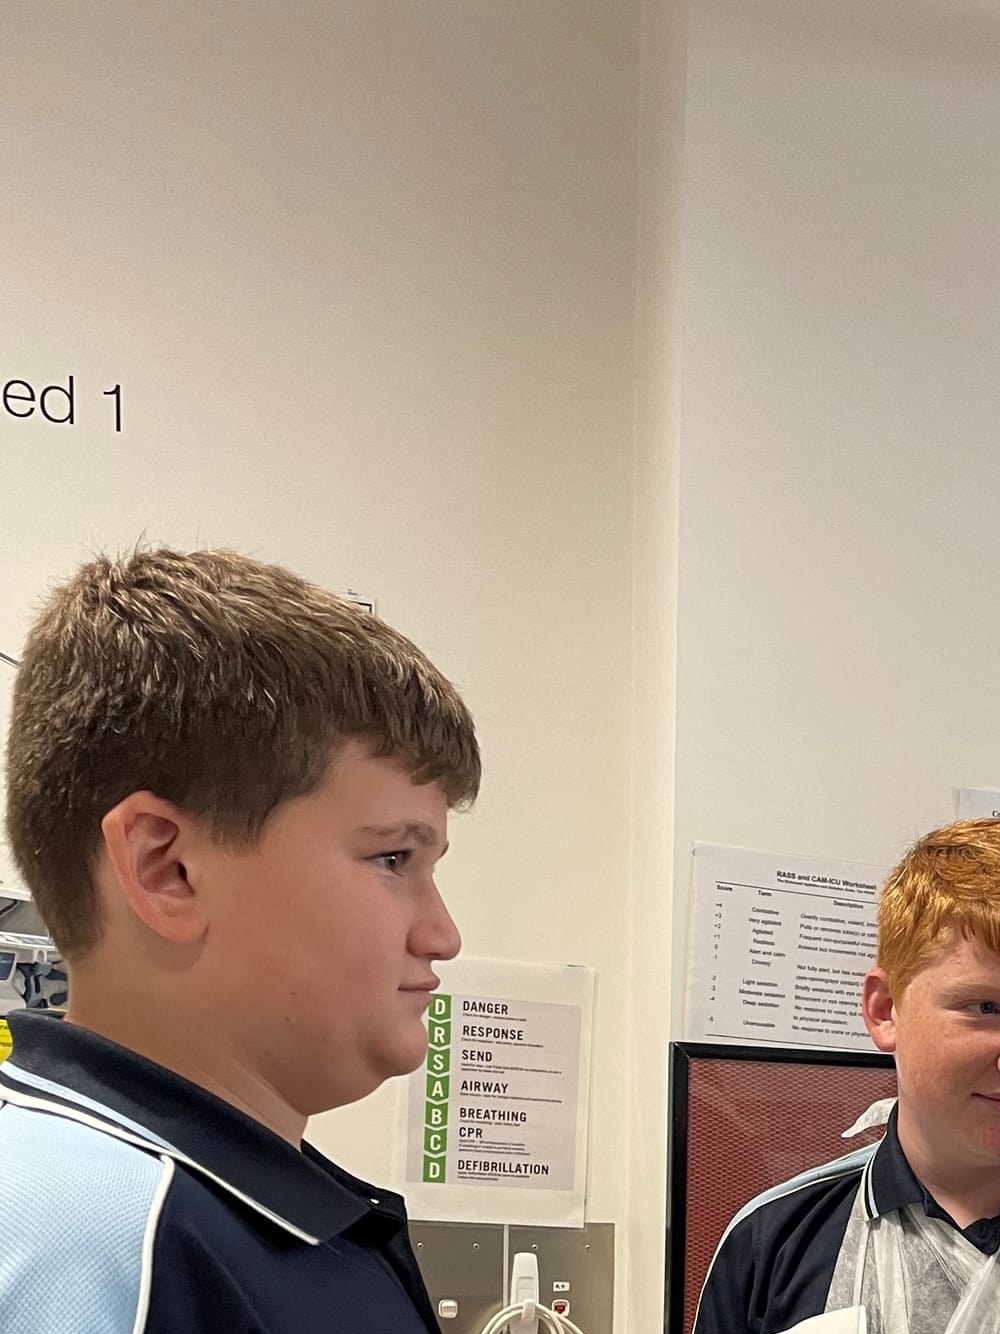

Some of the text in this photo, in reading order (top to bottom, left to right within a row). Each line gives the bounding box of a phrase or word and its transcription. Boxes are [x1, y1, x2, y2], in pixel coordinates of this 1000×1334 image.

[103, 384, 121, 432] 1
[777, 871, 796, 879] RASS
[811, 876, 841, 885] CAM-ICU
[842, 880, 877, 890] Worksheet
[435, 998, 446, 1015] D
[463, 1000, 508, 1015] DANGER
[434, 1026, 445, 1043] R
[463, 1025, 524, 1041] RESPONSE
[433, 1054, 444, 1071] S
[462, 1049, 492, 1062] SEND
[431, 1080, 444, 1098] A
[461, 1080, 508, 1094] AIRWAY
[431, 1108, 442, 1125] B
[460, 1107, 527, 1122] BREATHING
[459, 1127, 483, 1139] CPR
[430, 1134, 441, 1151] C
[429, 1162, 440, 1179] D
[458, 1160, 549, 1175] DEFIBRILLATION
